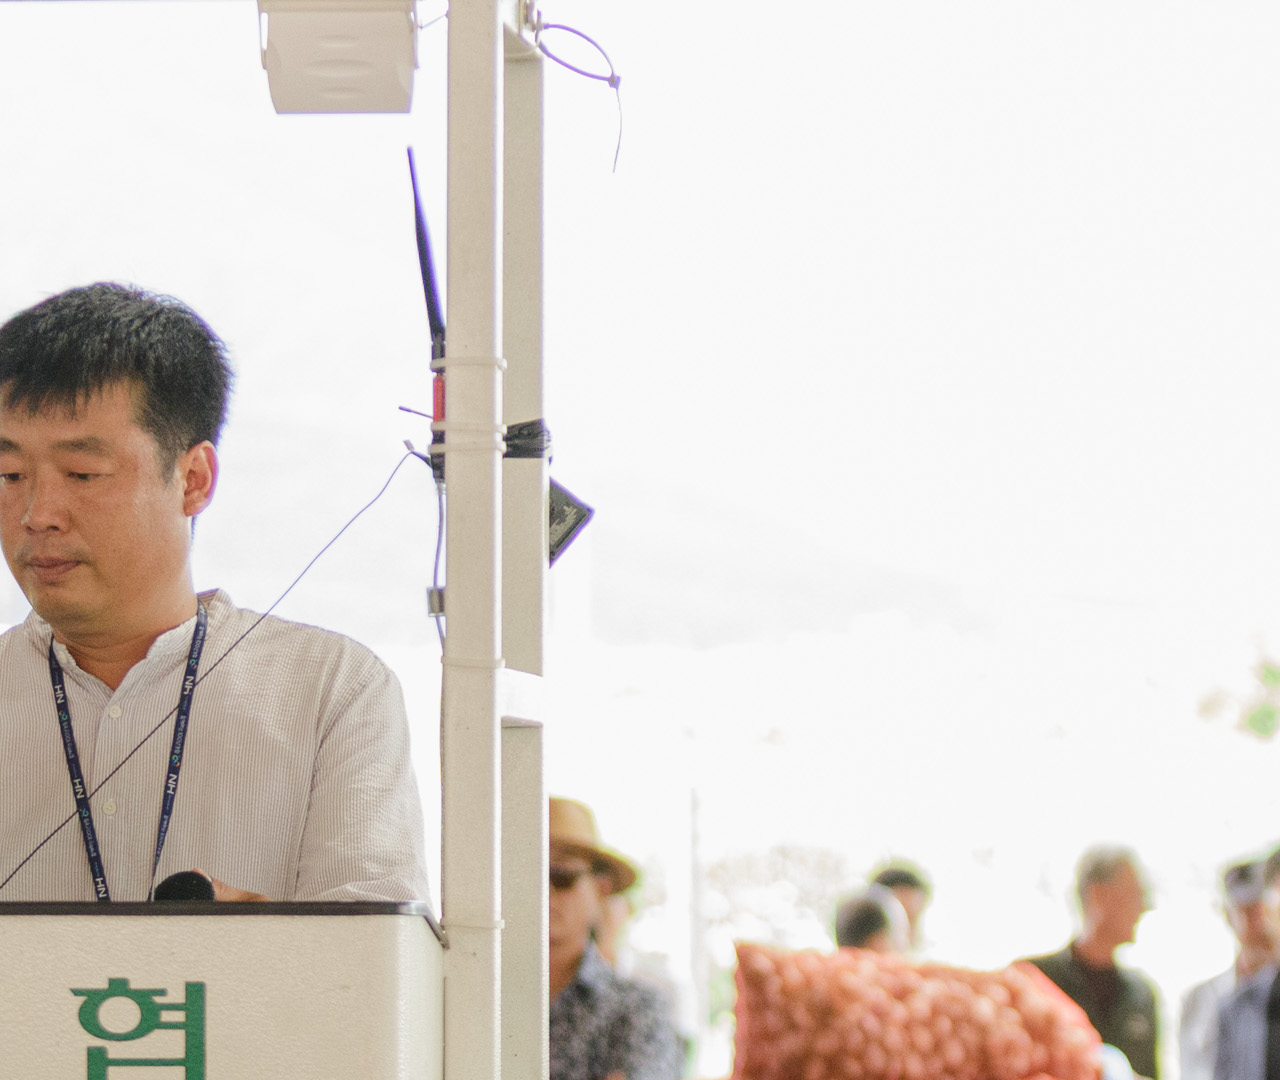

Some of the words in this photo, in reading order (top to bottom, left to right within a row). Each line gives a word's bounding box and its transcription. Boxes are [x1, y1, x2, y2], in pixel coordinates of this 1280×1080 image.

[54, 684, 65, 704] NH
[73, 778, 85, 799] NH
[167, 774, 178, 795] NH
[95, 877, 108, 898] NH
